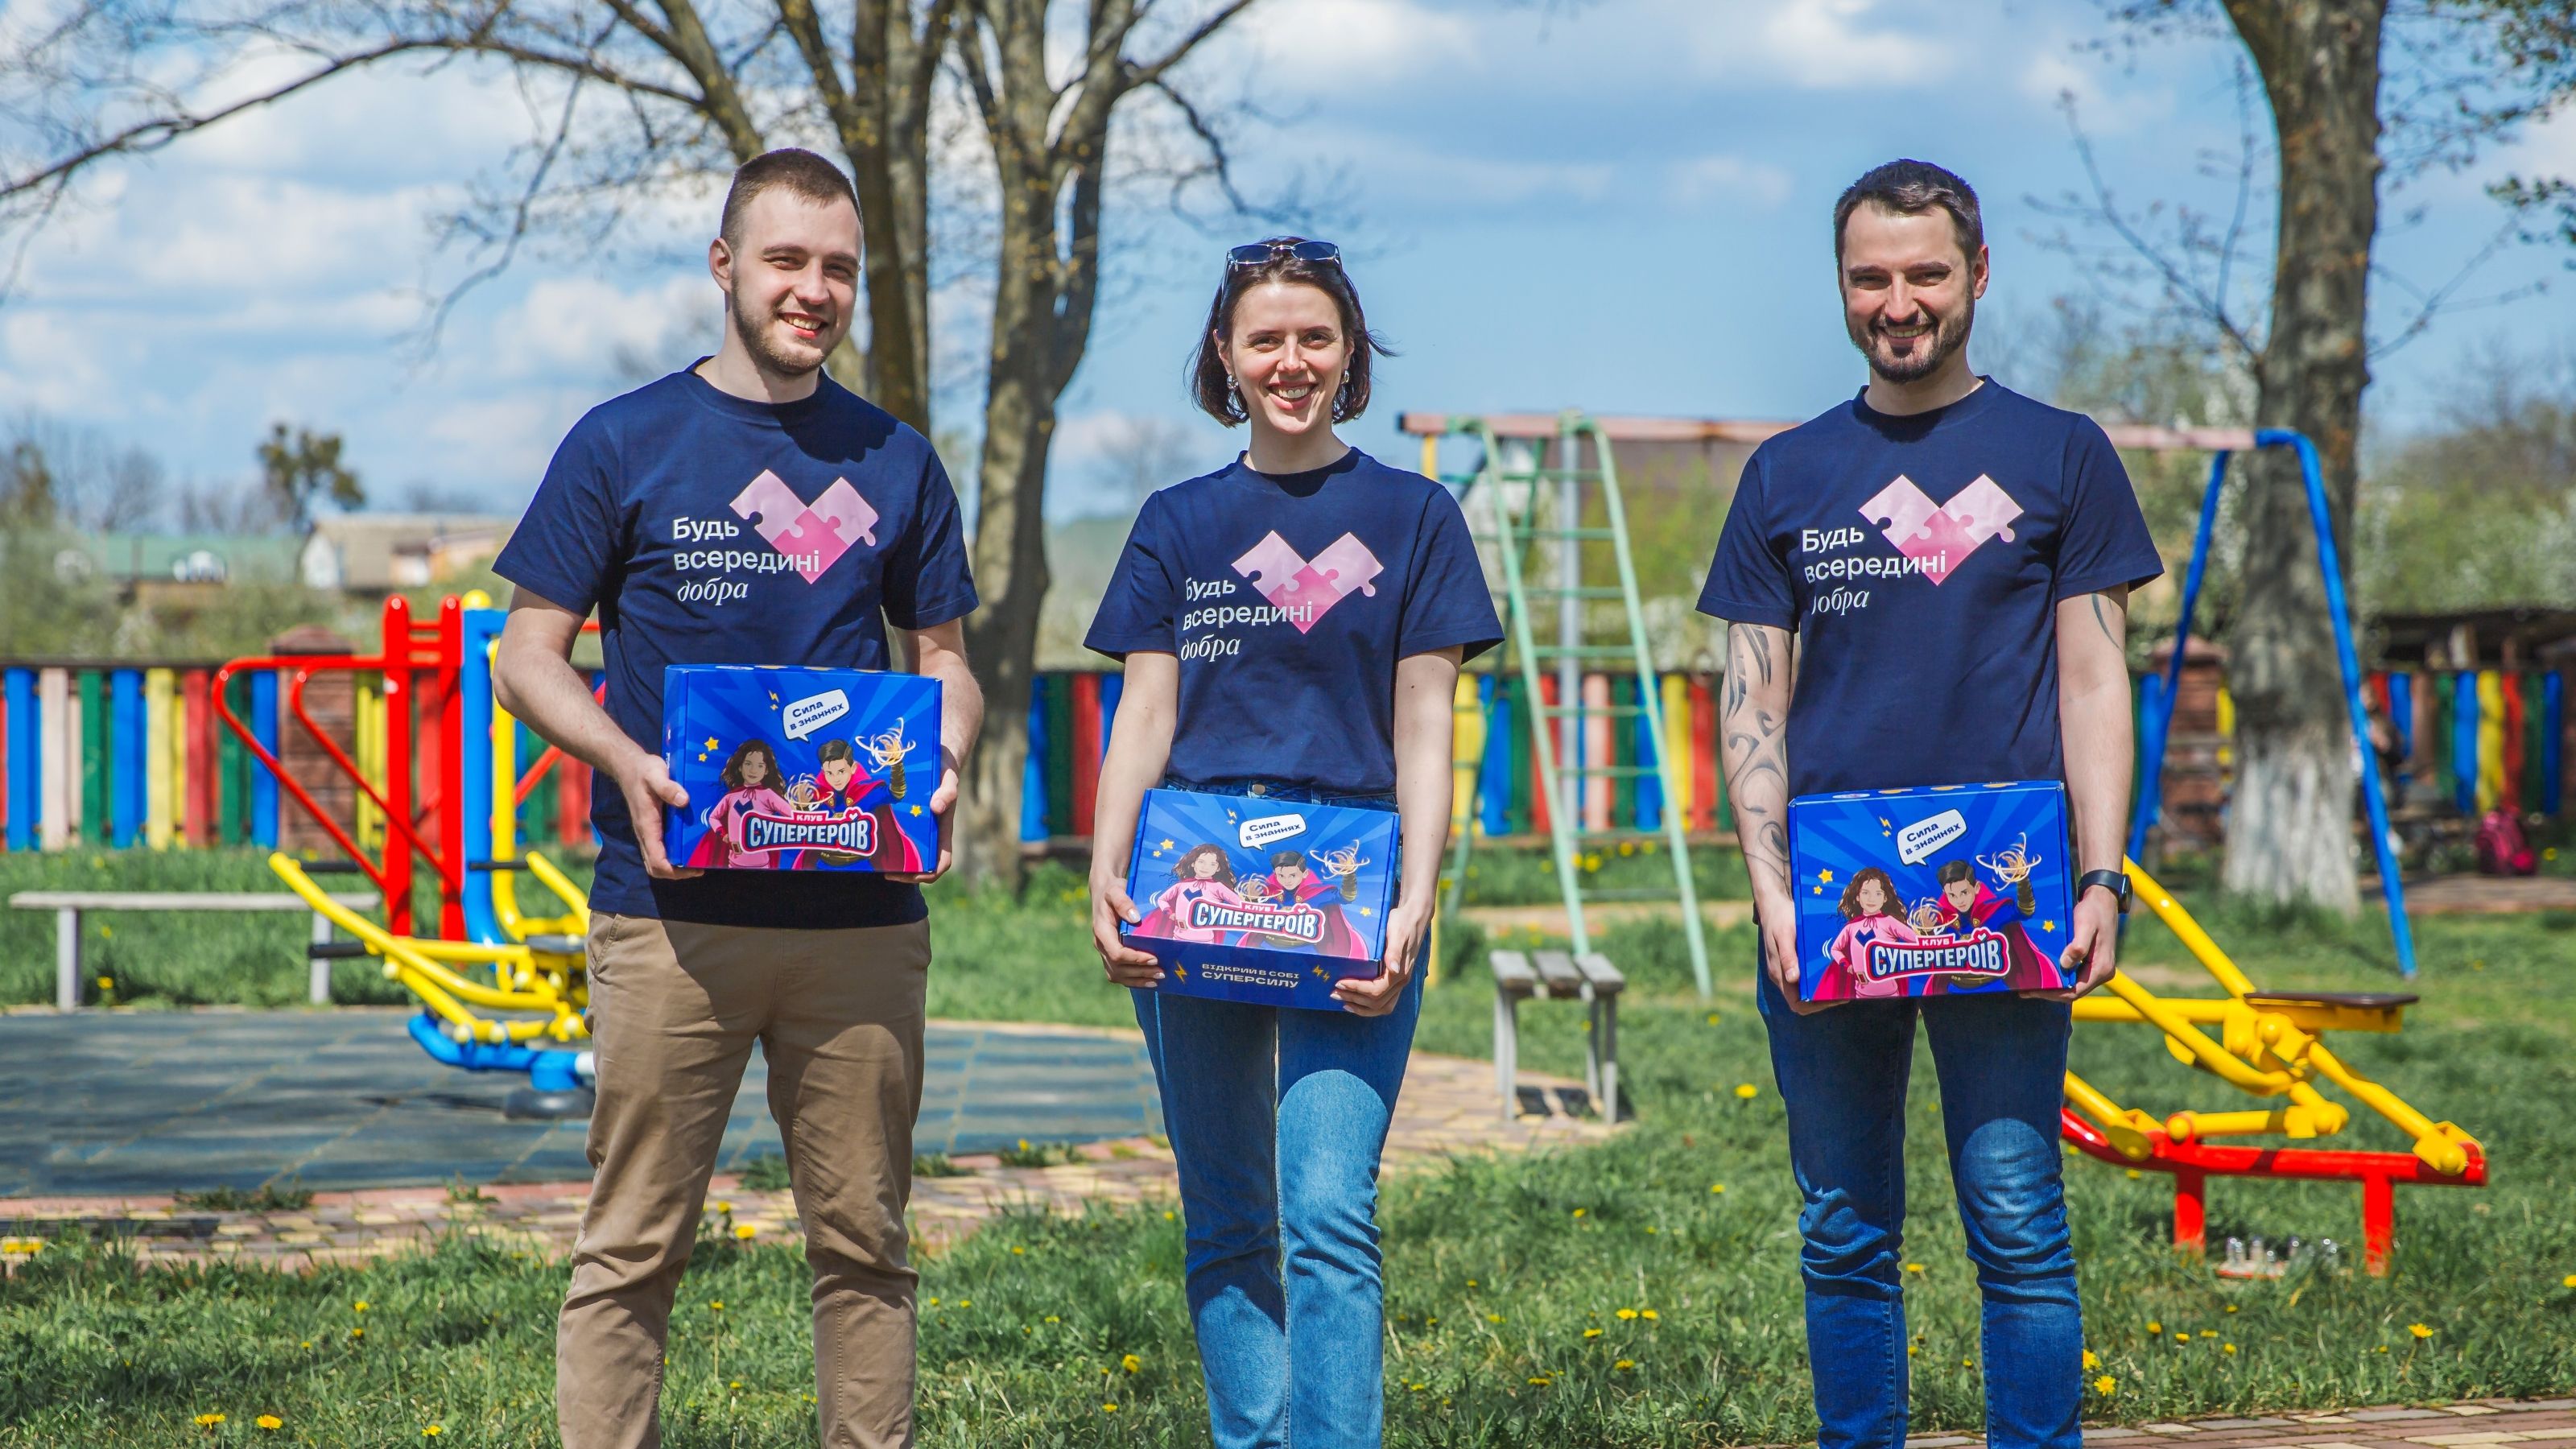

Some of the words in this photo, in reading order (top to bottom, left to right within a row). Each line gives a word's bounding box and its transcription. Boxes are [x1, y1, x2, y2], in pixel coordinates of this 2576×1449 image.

[673, 517, 739, 542] Будь
[1802, 527, 1864, 553] Будь
[674, 550, 819, 574] всередині
[1804, 550, 1946, 584] всередині
[677, 576, 749, 605] добра
[1186, 577, 1236, 602] Будь
[1183, 601, 1313, 631] всередині
[1181, 634, 1241, 663] добра
[792, 701, 824, 717] Сила
[798, 703, 844, 727] знаннях
[796, 814, 824, 822] КЛУБ
[1249, 821, 1281, 832] Сила
[749, 813, 869, 850] СУПЕРГЕРОЇВ
[1254, 824, 1301, 839] знаннях
[1906, 823, 1939, 842] Сила
[1913, 823, 1961, 851] знаннях
[1196, 902, 1316, 939] СУПЕРГЕРОЇВ
[1874, 933, 2000, 976] СУПЕРГЕРОЇВ
[1922, 938, 1950, 946] КЛУБ
[1202, 971, 1298, 989] СУПЕРСИЛУ
[1269, 971, 1299, 979] СОБІ
